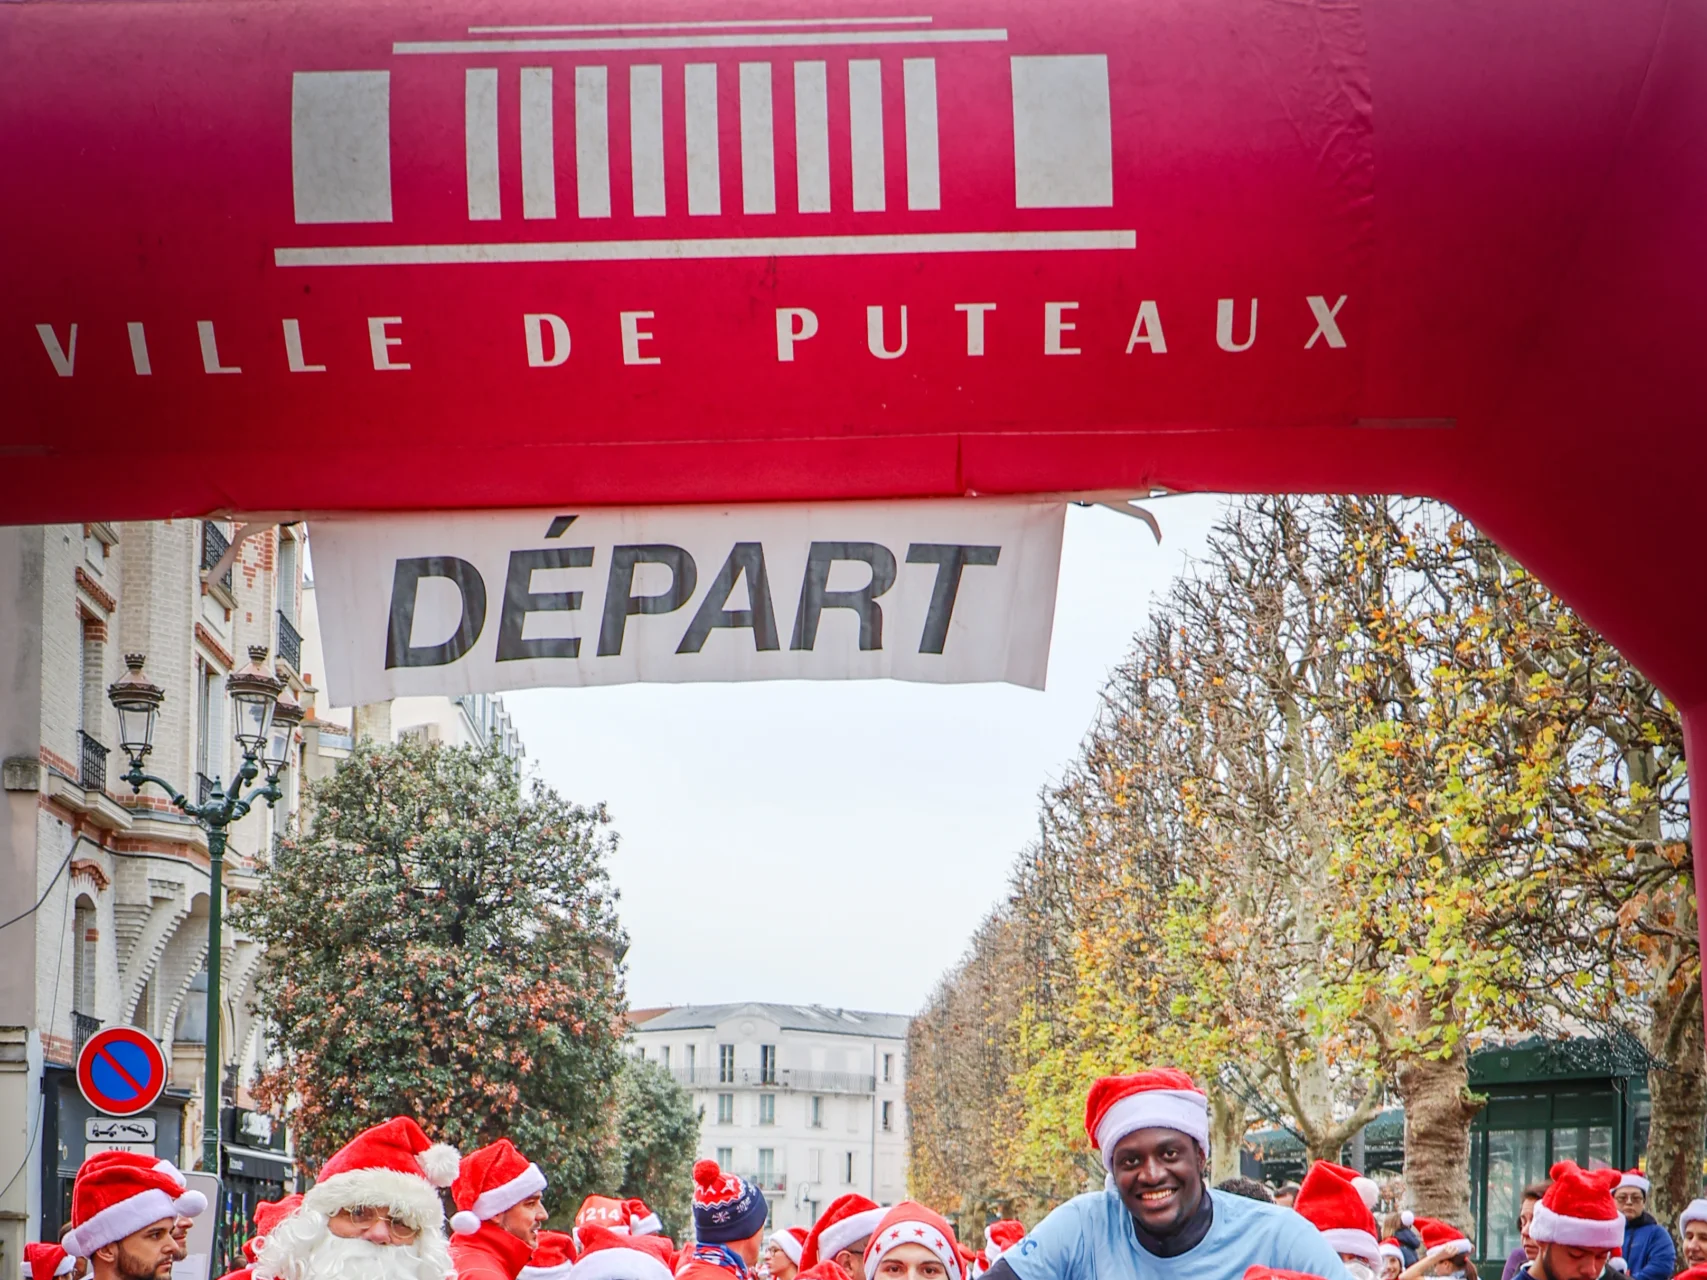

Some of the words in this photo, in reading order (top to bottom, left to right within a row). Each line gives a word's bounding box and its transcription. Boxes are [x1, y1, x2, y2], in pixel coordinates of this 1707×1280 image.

[35, 316, 412, 377] VILLE
[524, 311, 661, 368] DE
[776, 295, 1348, 362] PUTEAUX
[385, 515, 1001, 670] DÉPART
[578, 1206, 620, 1224] 1214
